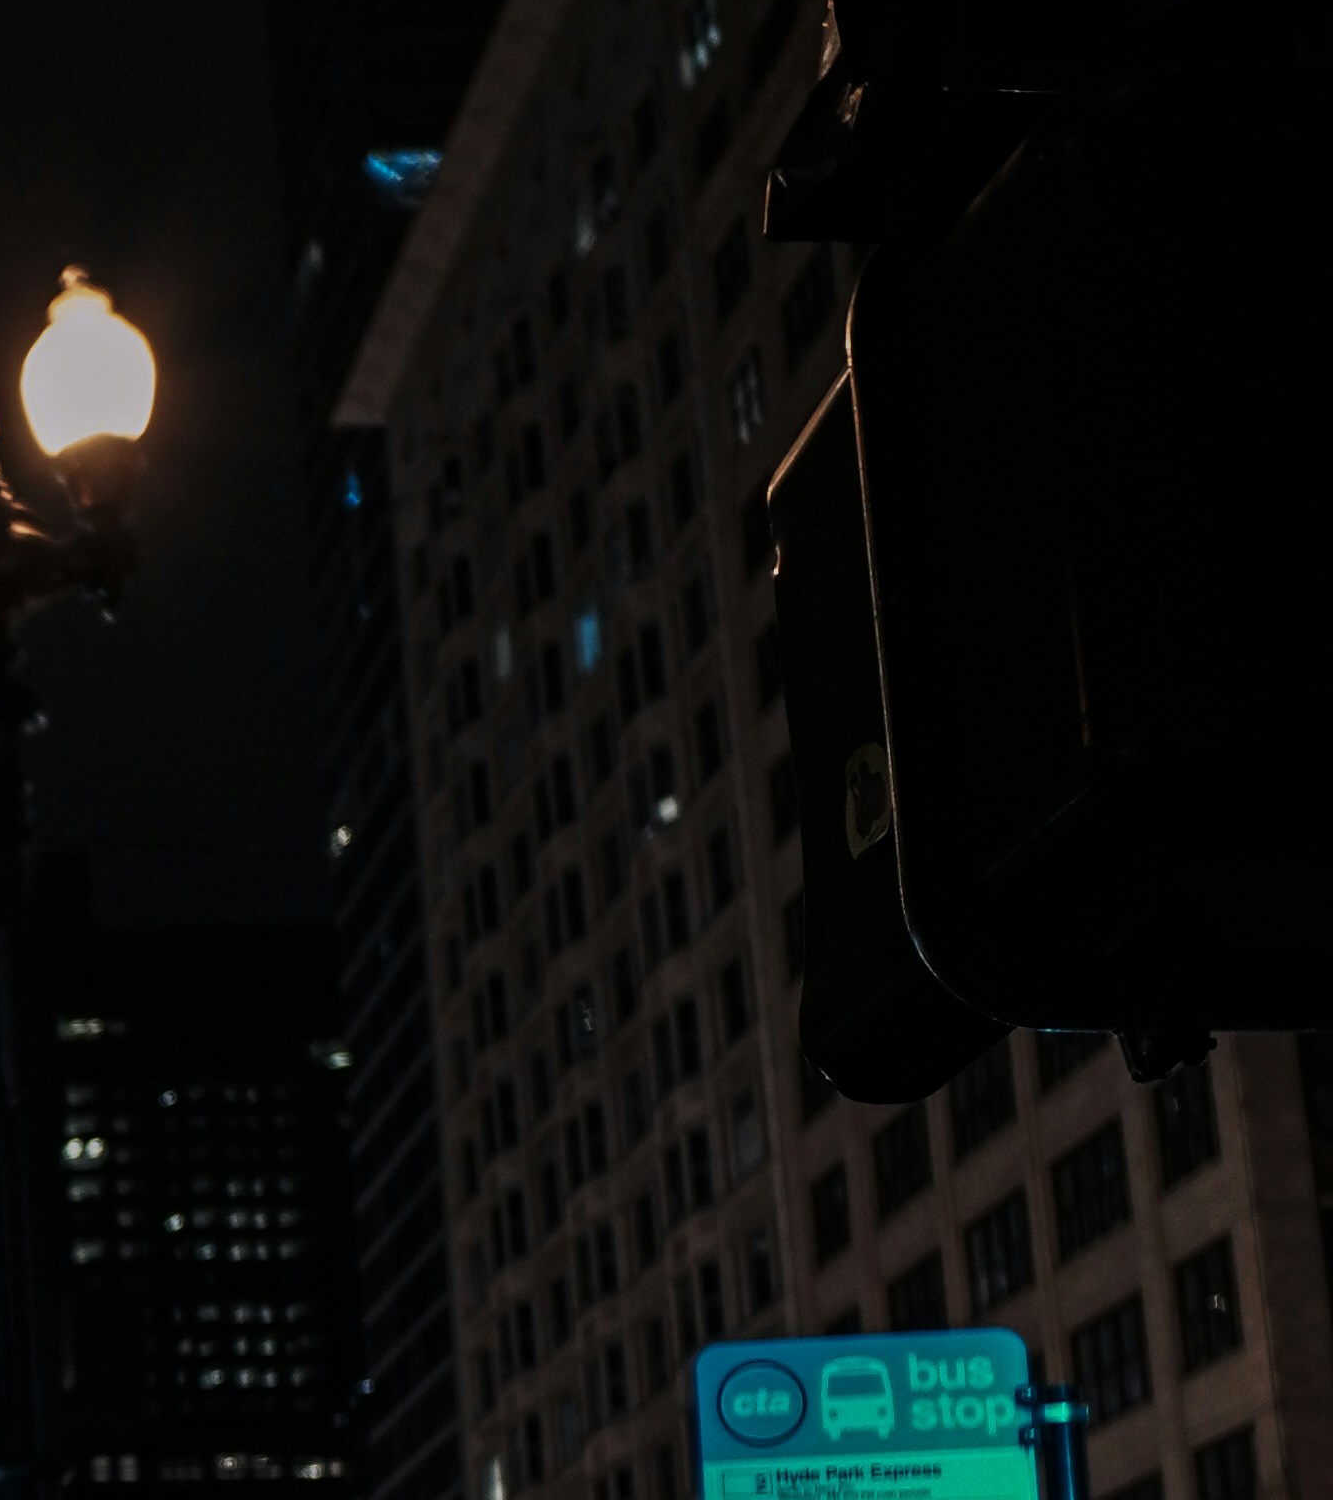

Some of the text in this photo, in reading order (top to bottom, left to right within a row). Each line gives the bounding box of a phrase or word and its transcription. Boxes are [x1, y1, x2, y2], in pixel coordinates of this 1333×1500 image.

[907, 1352, 995, 1392] bus
[731, 1386, 792, 1419] cta
[910, 1393, 1016, 1438] stop
[776, 1466, 820, 1487] Hyde
[825, 1464, 865, 1482] Park
[870, 1462, 943, 1482] Express
